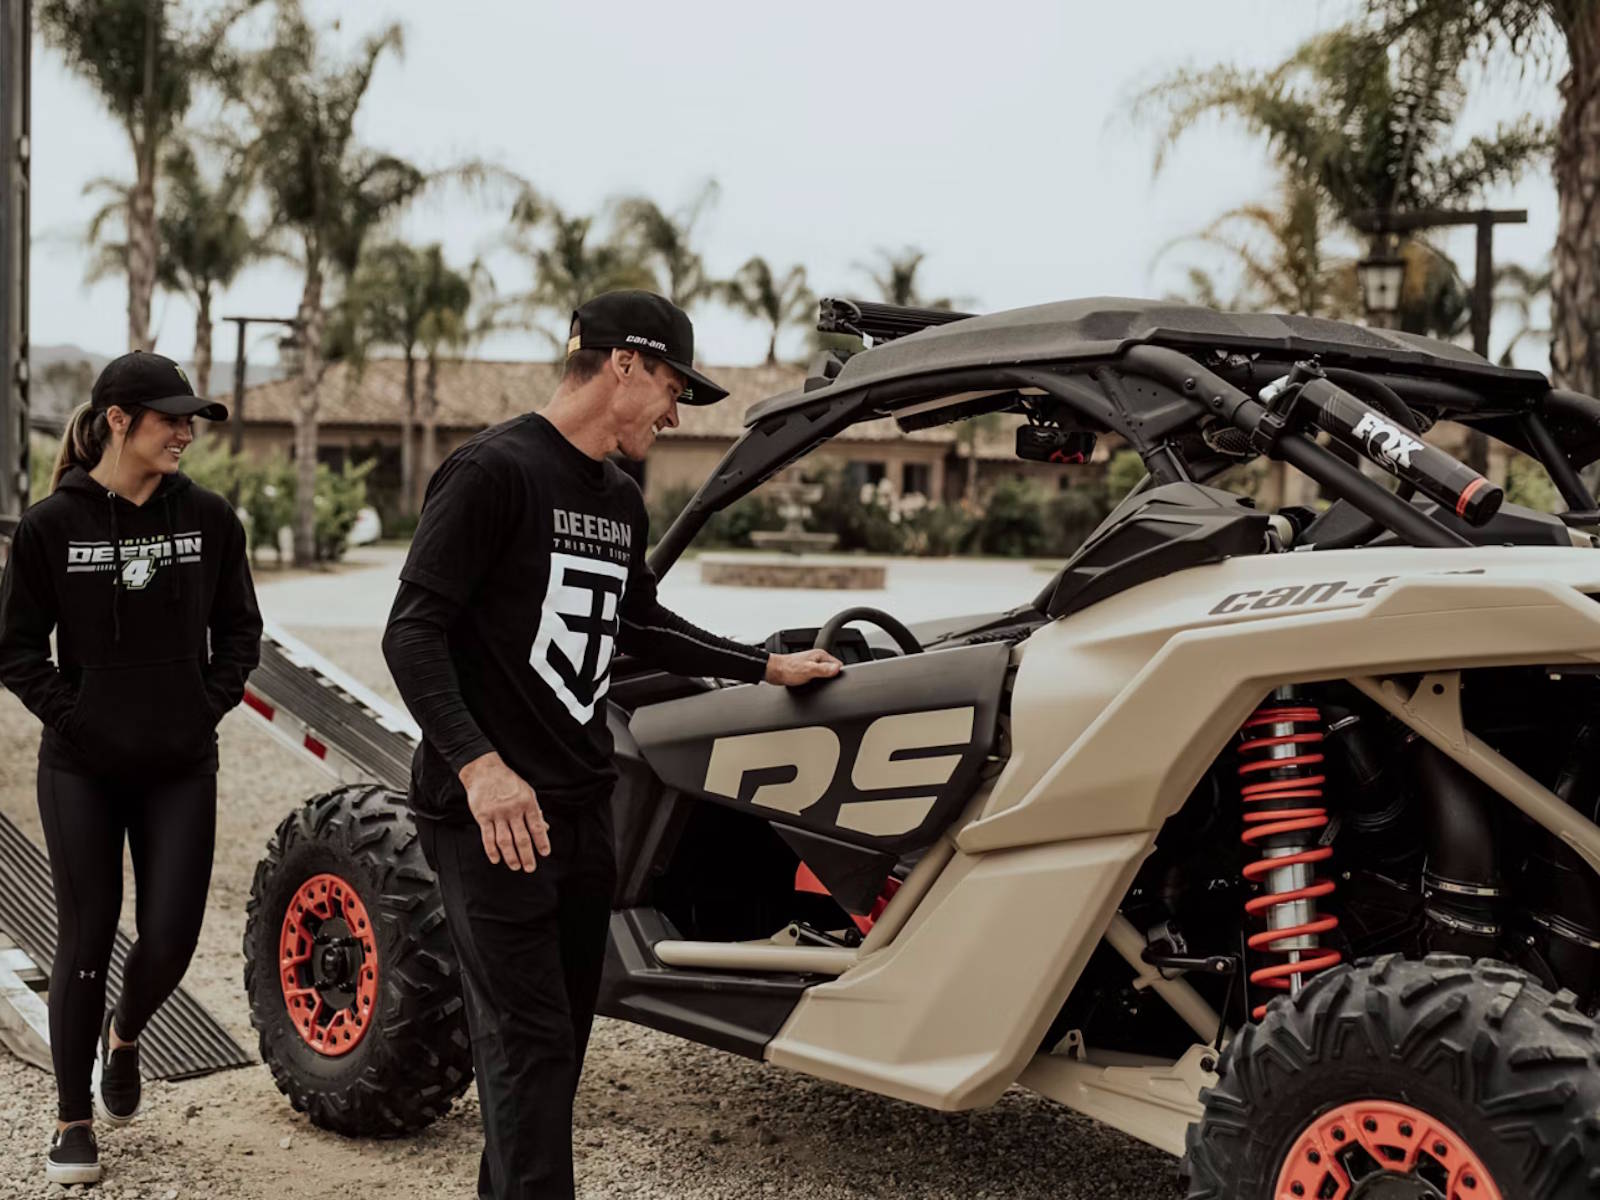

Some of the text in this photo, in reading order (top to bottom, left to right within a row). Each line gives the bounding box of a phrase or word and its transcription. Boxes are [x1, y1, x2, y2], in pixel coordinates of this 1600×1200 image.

[1352, 412, 1425, 474] FOX
[553, 508, 632, 548] DEEGAN
[553, 538, 602, 555] THIRTY
[121, 557, 155, 589] 4
[703, 705, 975, 837] RS
